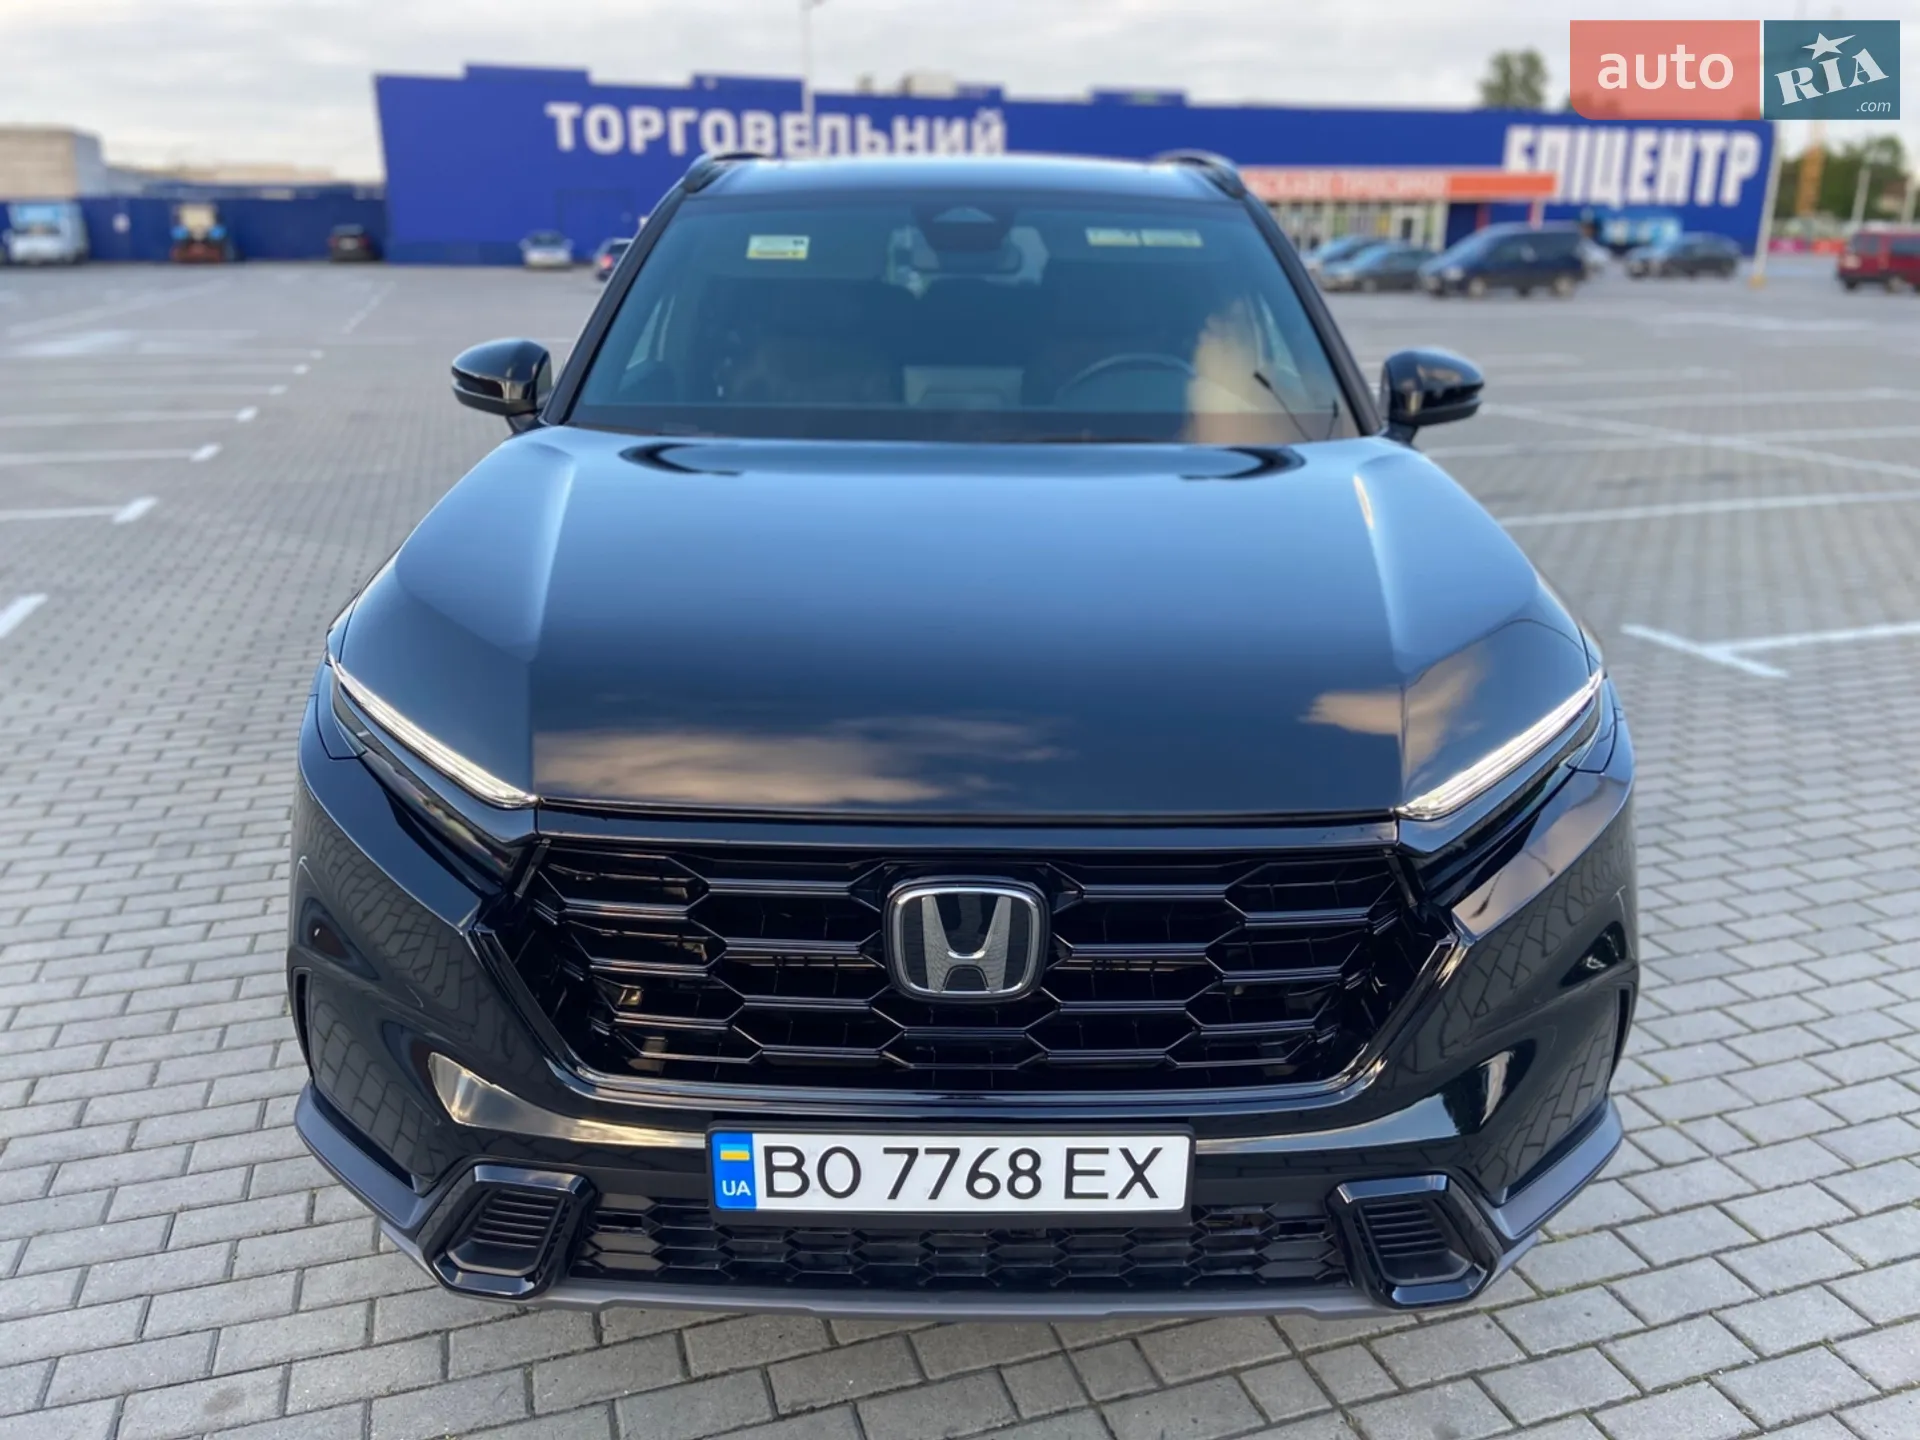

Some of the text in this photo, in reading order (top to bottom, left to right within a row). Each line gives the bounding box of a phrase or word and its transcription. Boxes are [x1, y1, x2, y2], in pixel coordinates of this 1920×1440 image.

[545, 102, 1007, 156] ТОРГОВЕЛЬНИЙ
[721, 1180, 751, 1196] UA
[764, 1146, 1163, 1201] BO 7768 EX
